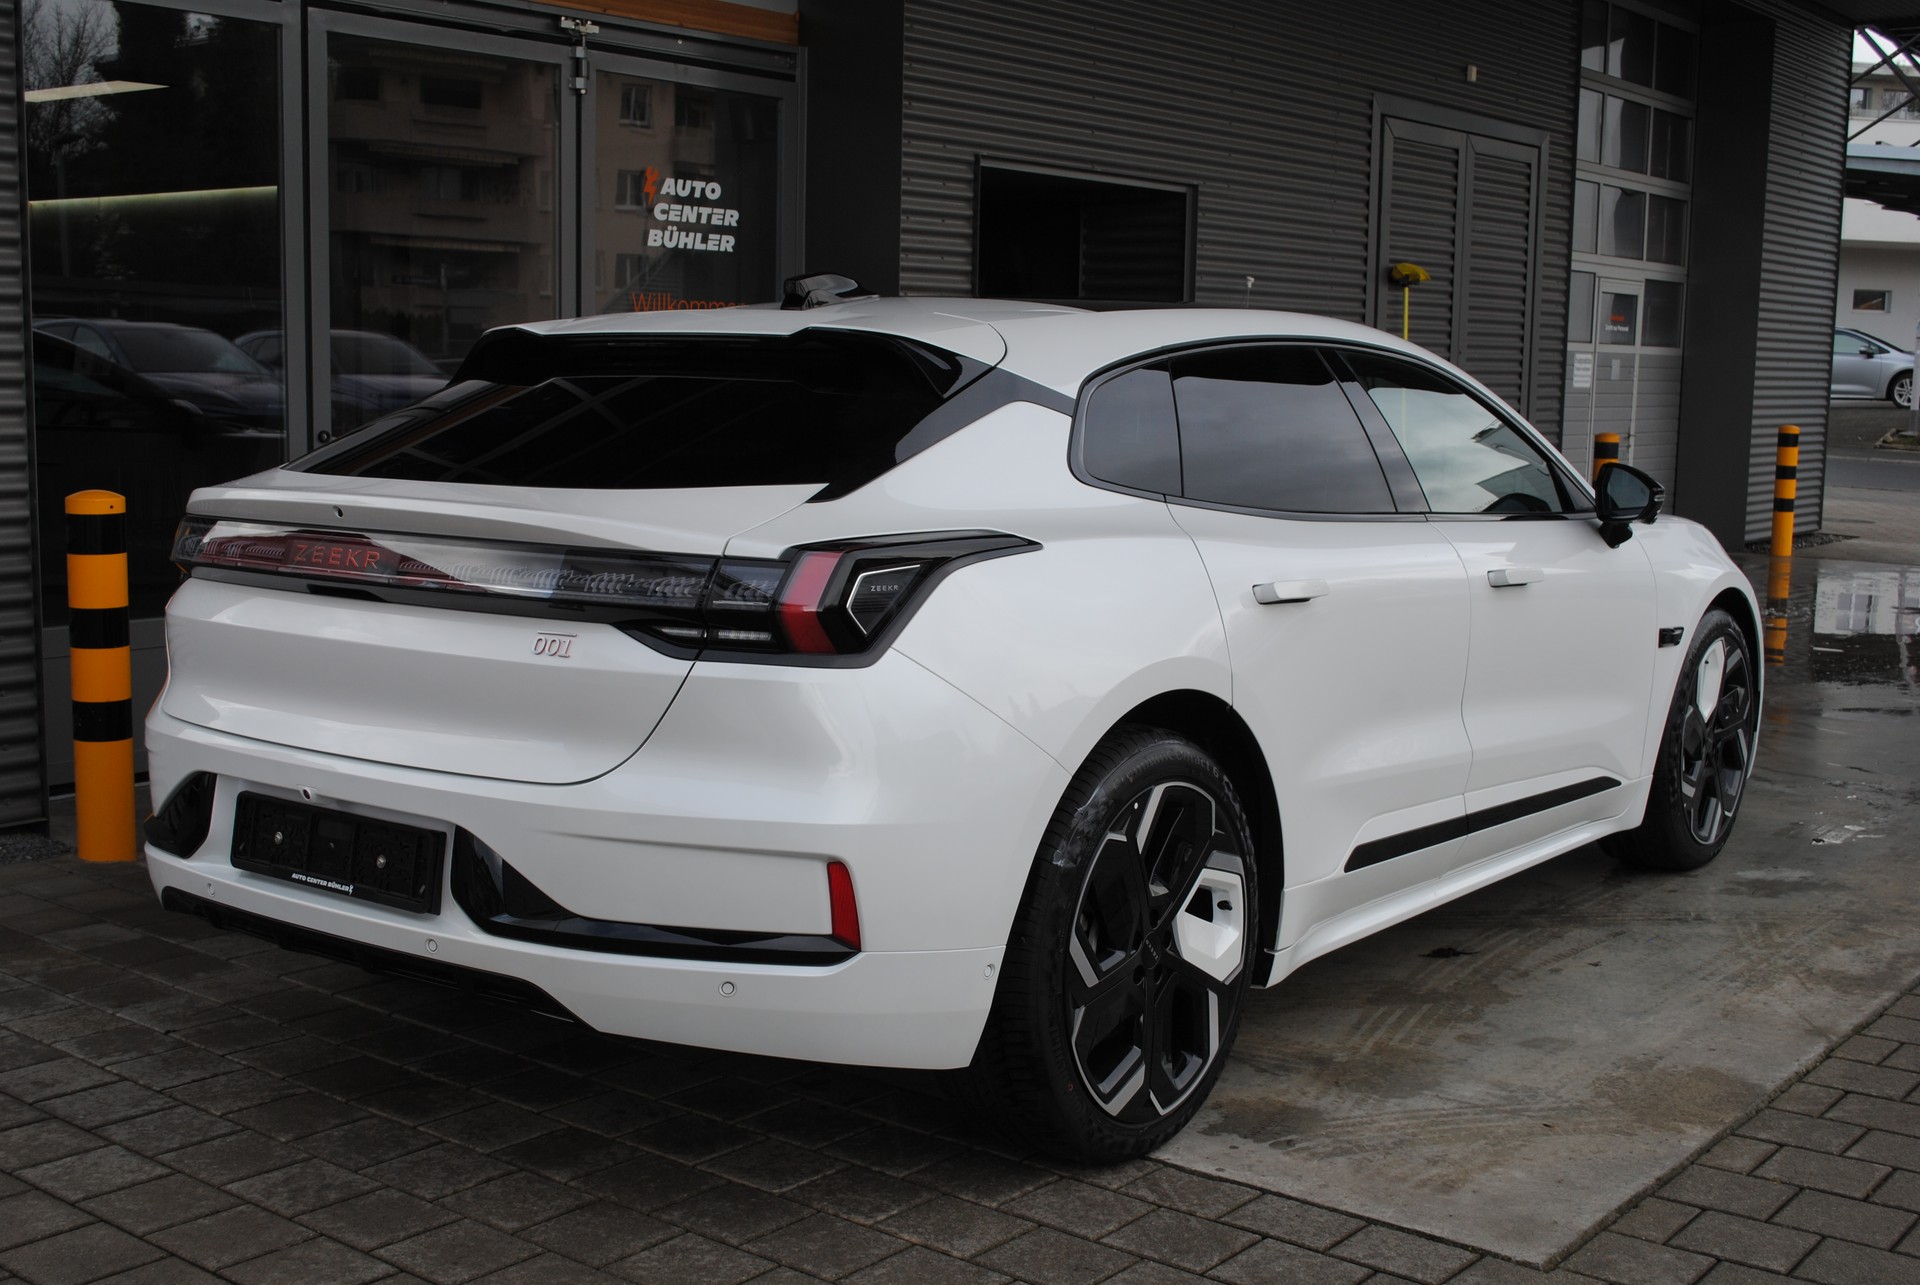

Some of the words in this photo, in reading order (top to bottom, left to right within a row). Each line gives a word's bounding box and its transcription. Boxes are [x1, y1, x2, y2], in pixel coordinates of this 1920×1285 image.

[660, 178, 721, 200] AUTO
[653, 203, 739, 227] CENTER
[647, 225, 735, 252] BÜHLER
[294, 544, 380, 569] ZEEKR
[531, 635, 572, 658] 001
[291, 873, 306, 881] AUTO
[307, 877, 327, 886] CENTER
[328, 881, 349, 891] BÜHLER
